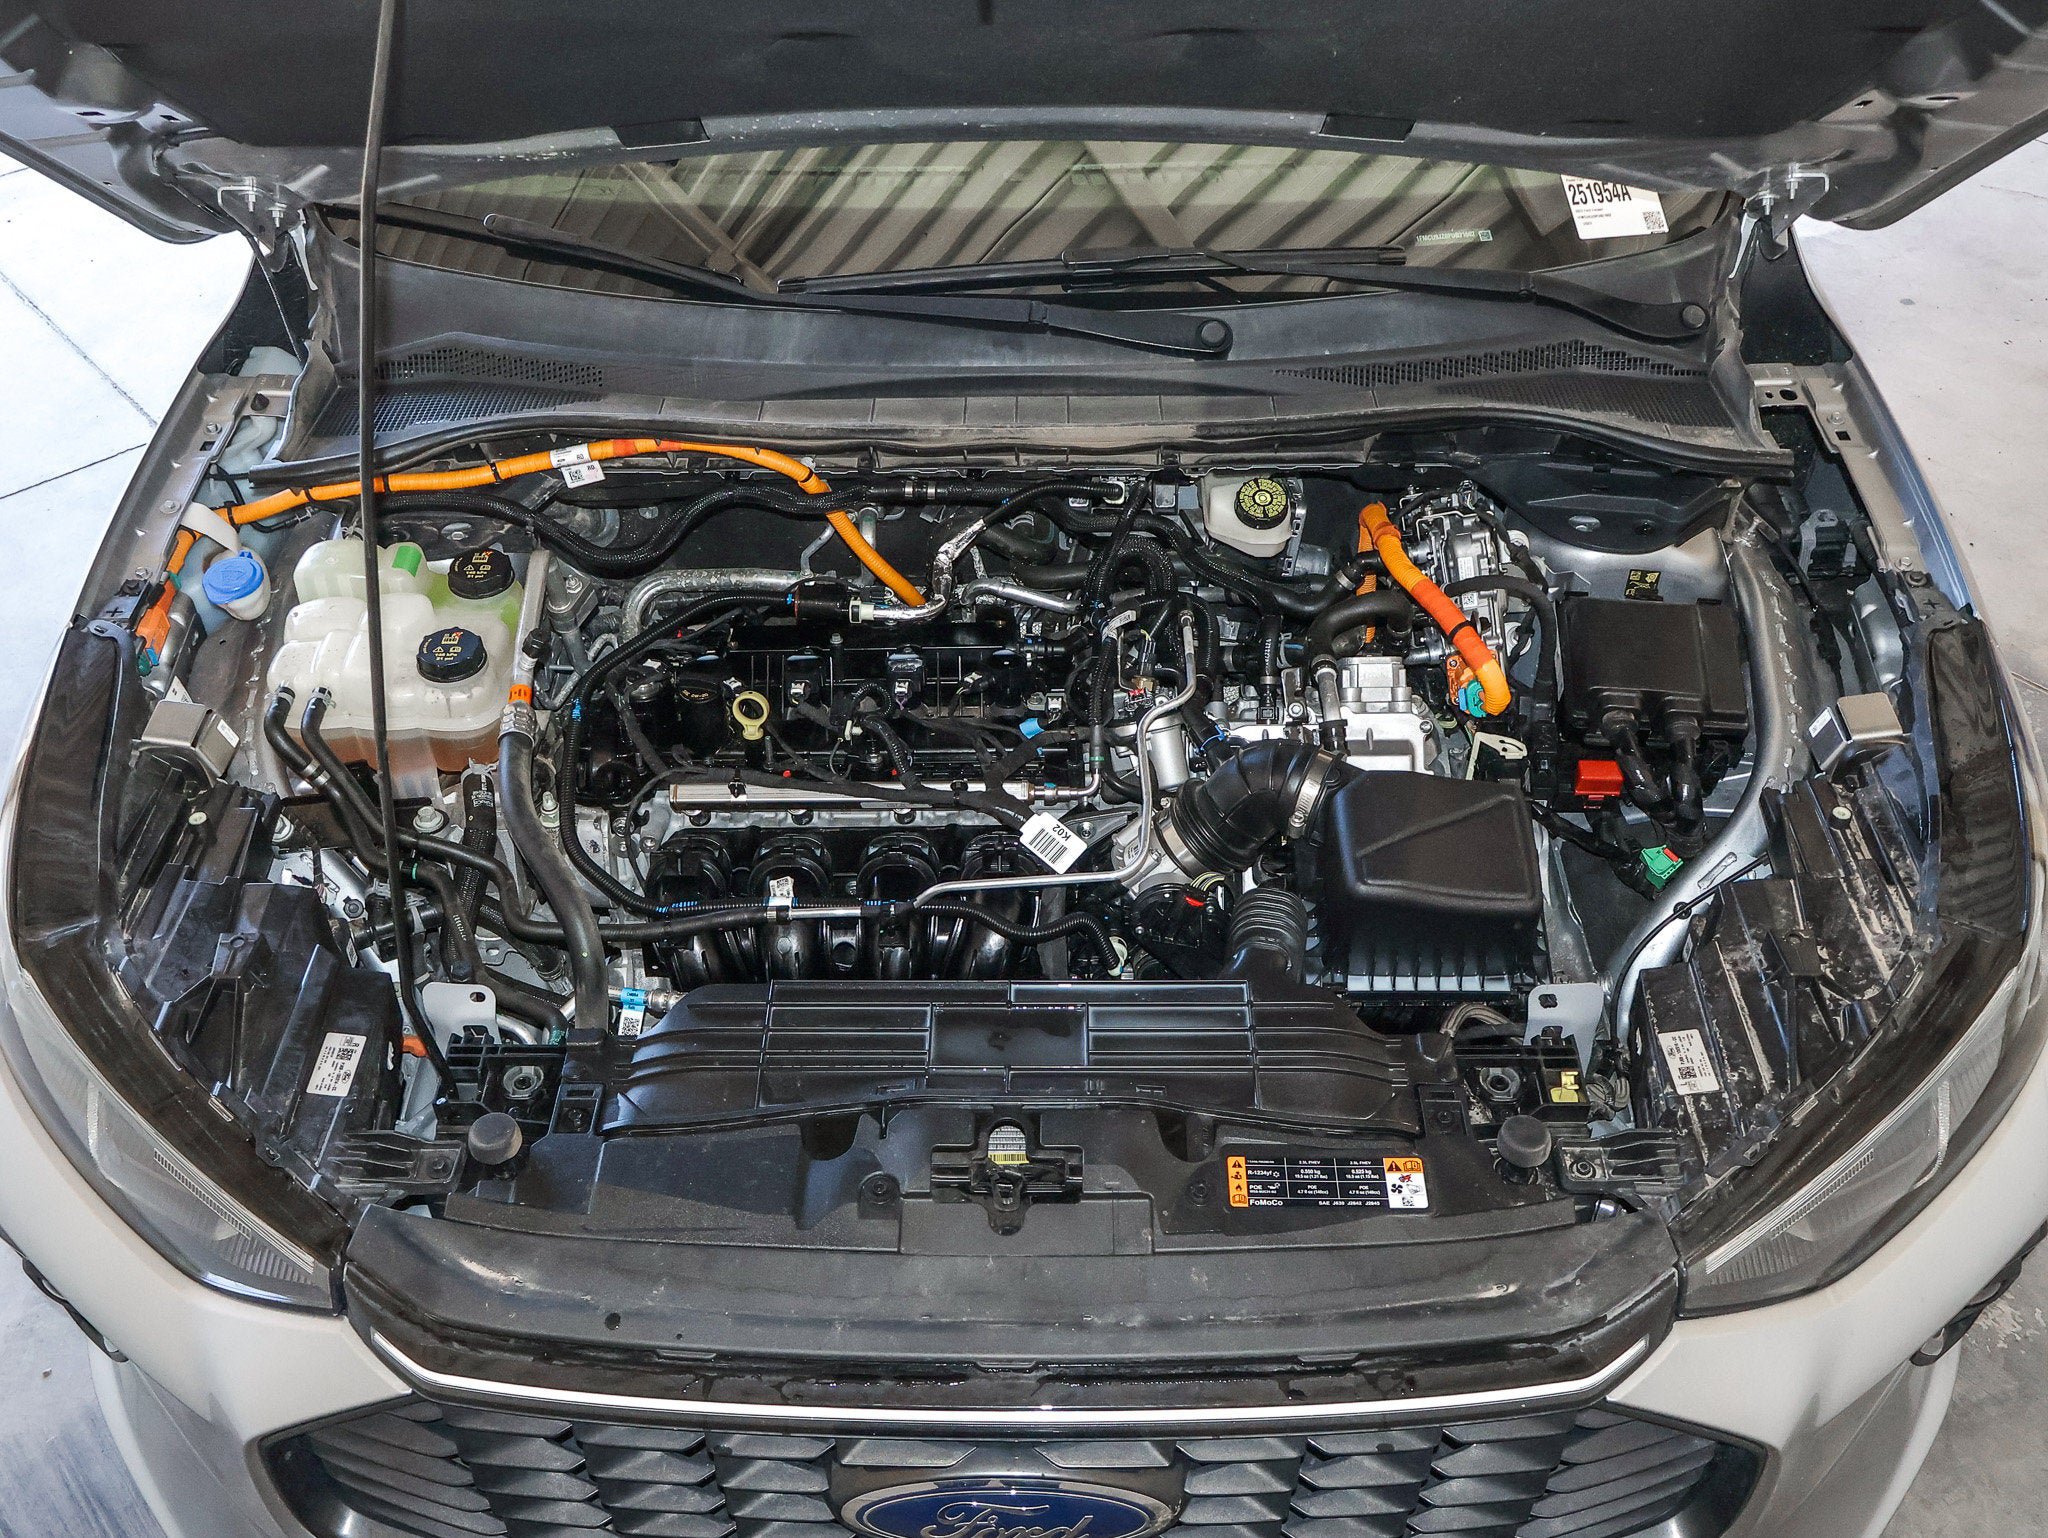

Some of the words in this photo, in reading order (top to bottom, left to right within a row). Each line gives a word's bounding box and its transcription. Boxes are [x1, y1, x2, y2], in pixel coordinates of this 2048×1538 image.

[1568, 182, 1632, 205] 251954A
[1052, 824, 1071, 842] K02
[921, 1502, 1094, 1538] Ford
